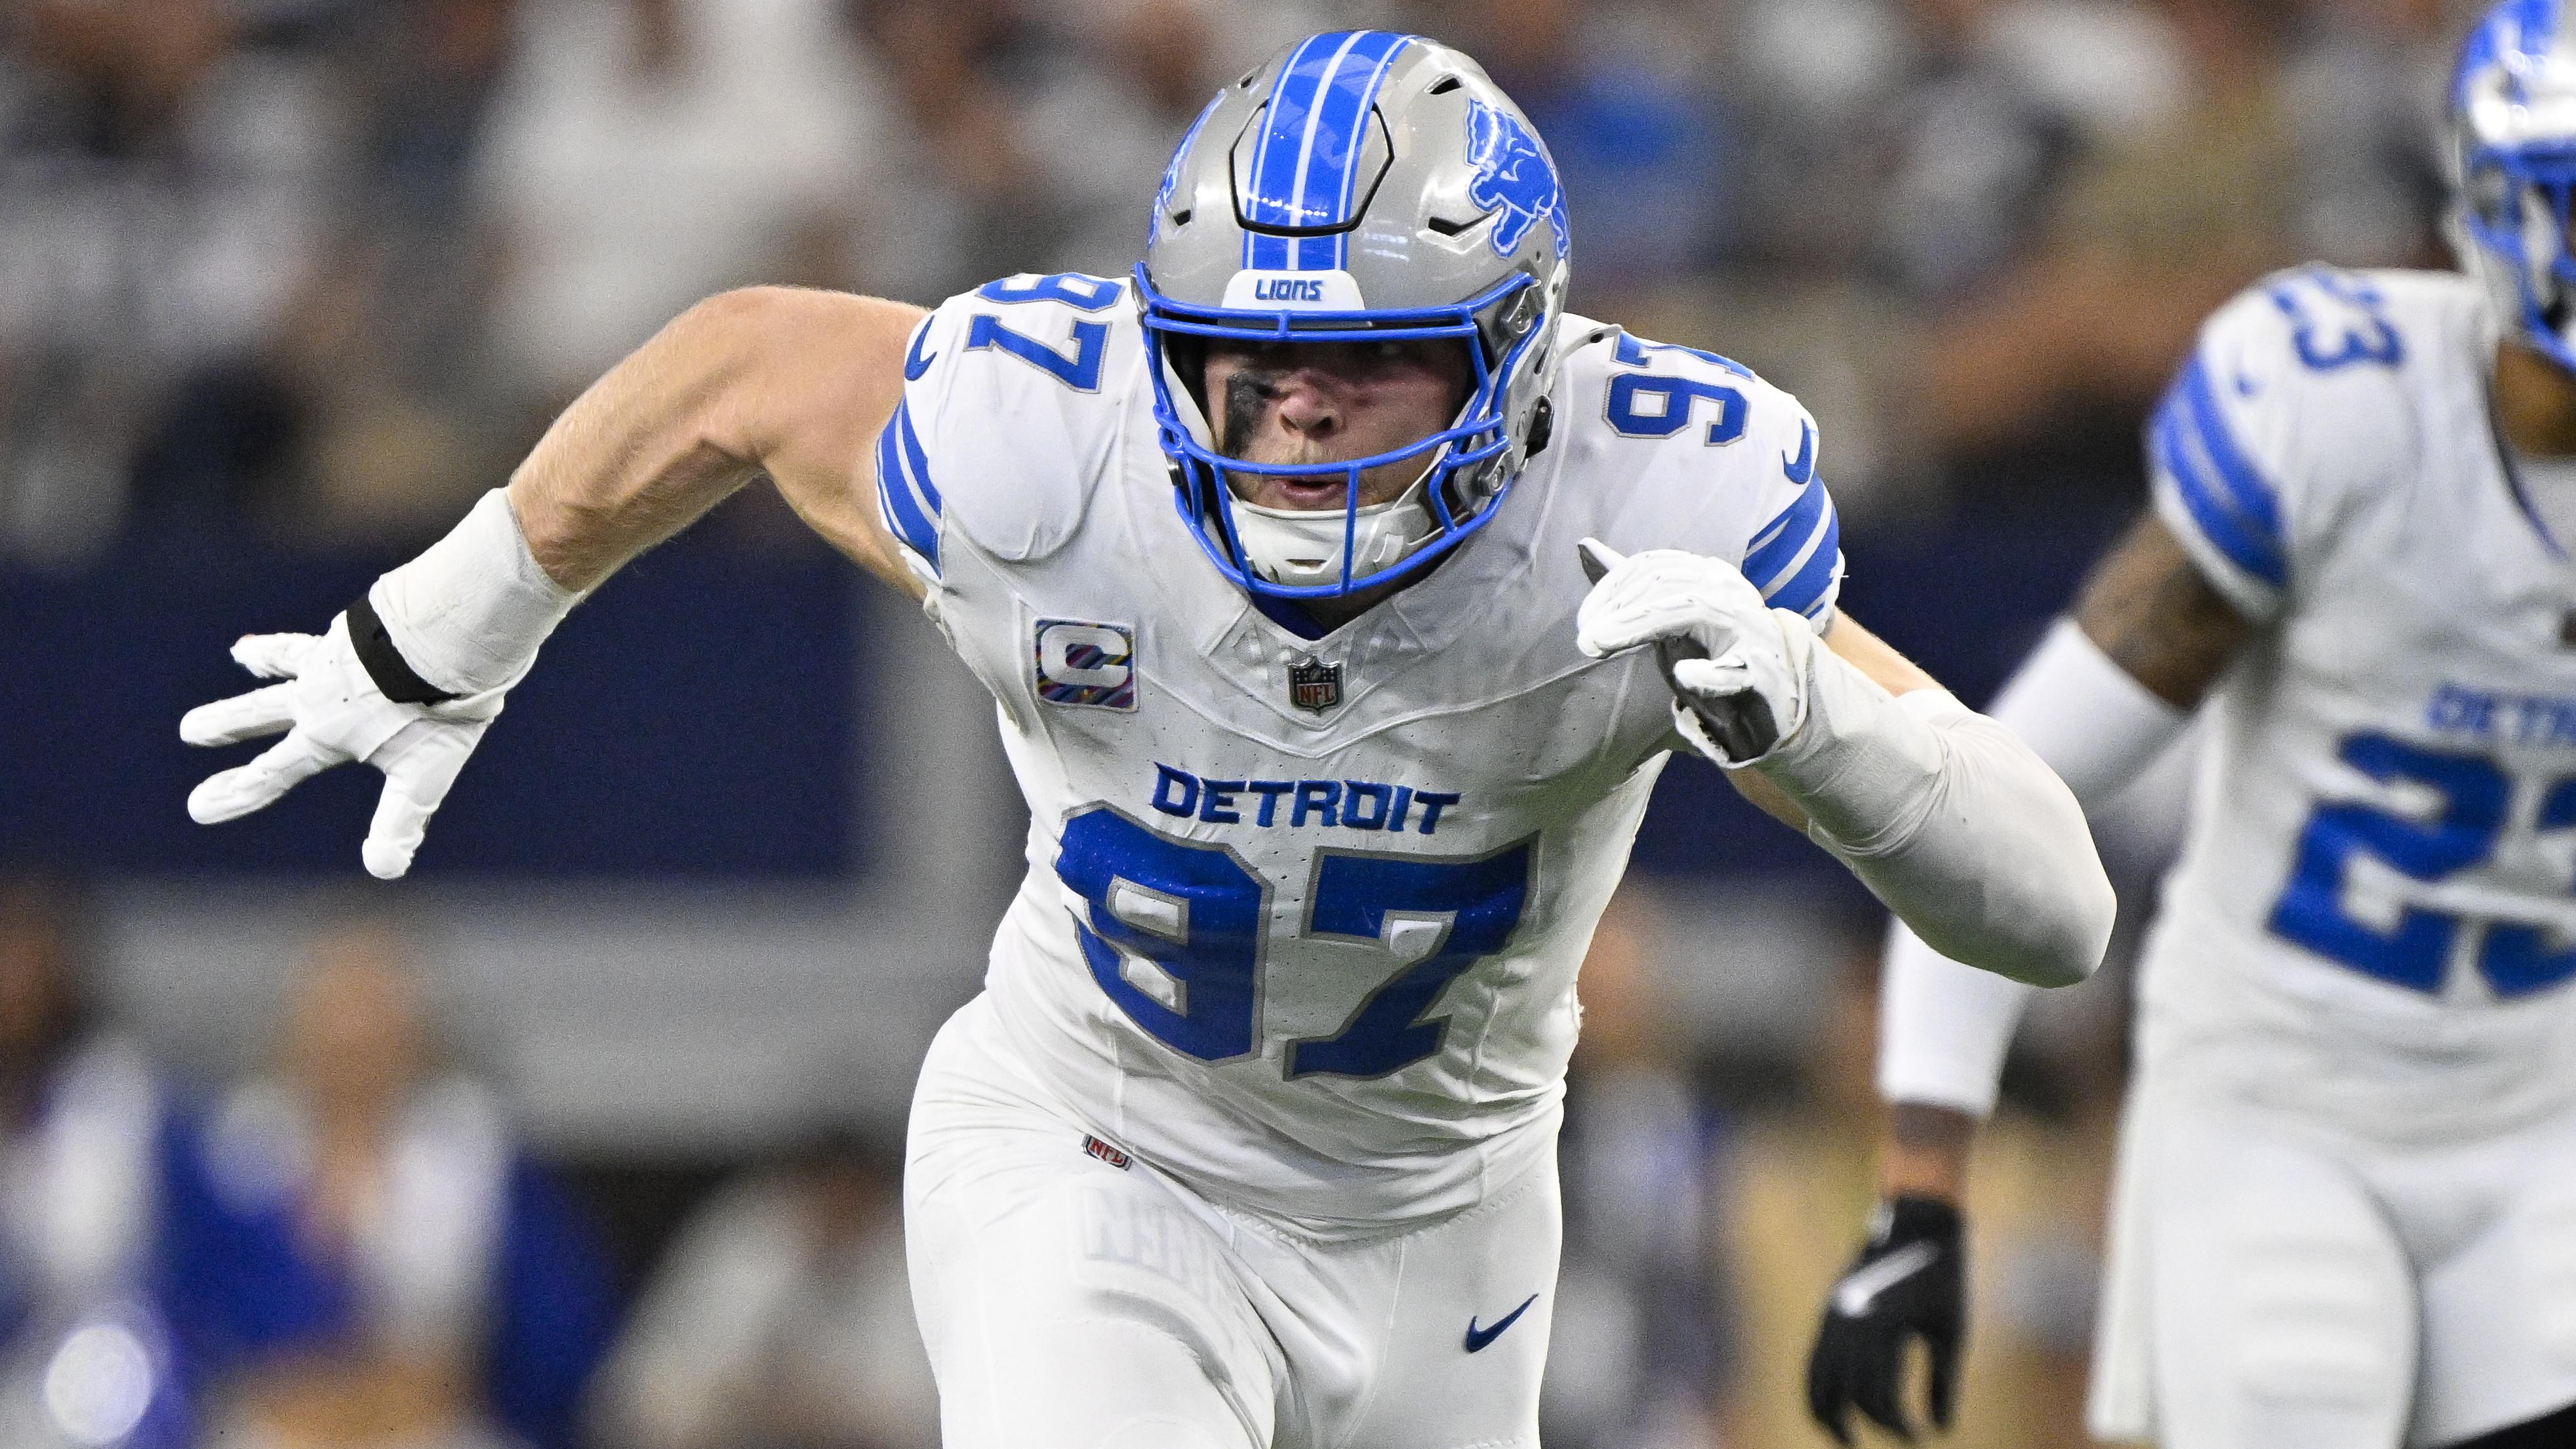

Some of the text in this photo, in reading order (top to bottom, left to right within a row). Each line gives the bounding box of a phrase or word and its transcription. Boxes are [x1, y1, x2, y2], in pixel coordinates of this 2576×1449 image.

[1255, 279, 1323, 301] LIONS
[963, 272, 1125, 393] 97
[1602, 330, 1755, 447] 97
[1041, 624, 1130, 688] C
[1300, 685, 1335, 705] NFL
[1152, 761, 1460, 835] DETROIT
[1051, 800, 1541, 1082] 97
[1090, 1138, 1123, 1164] NFL
